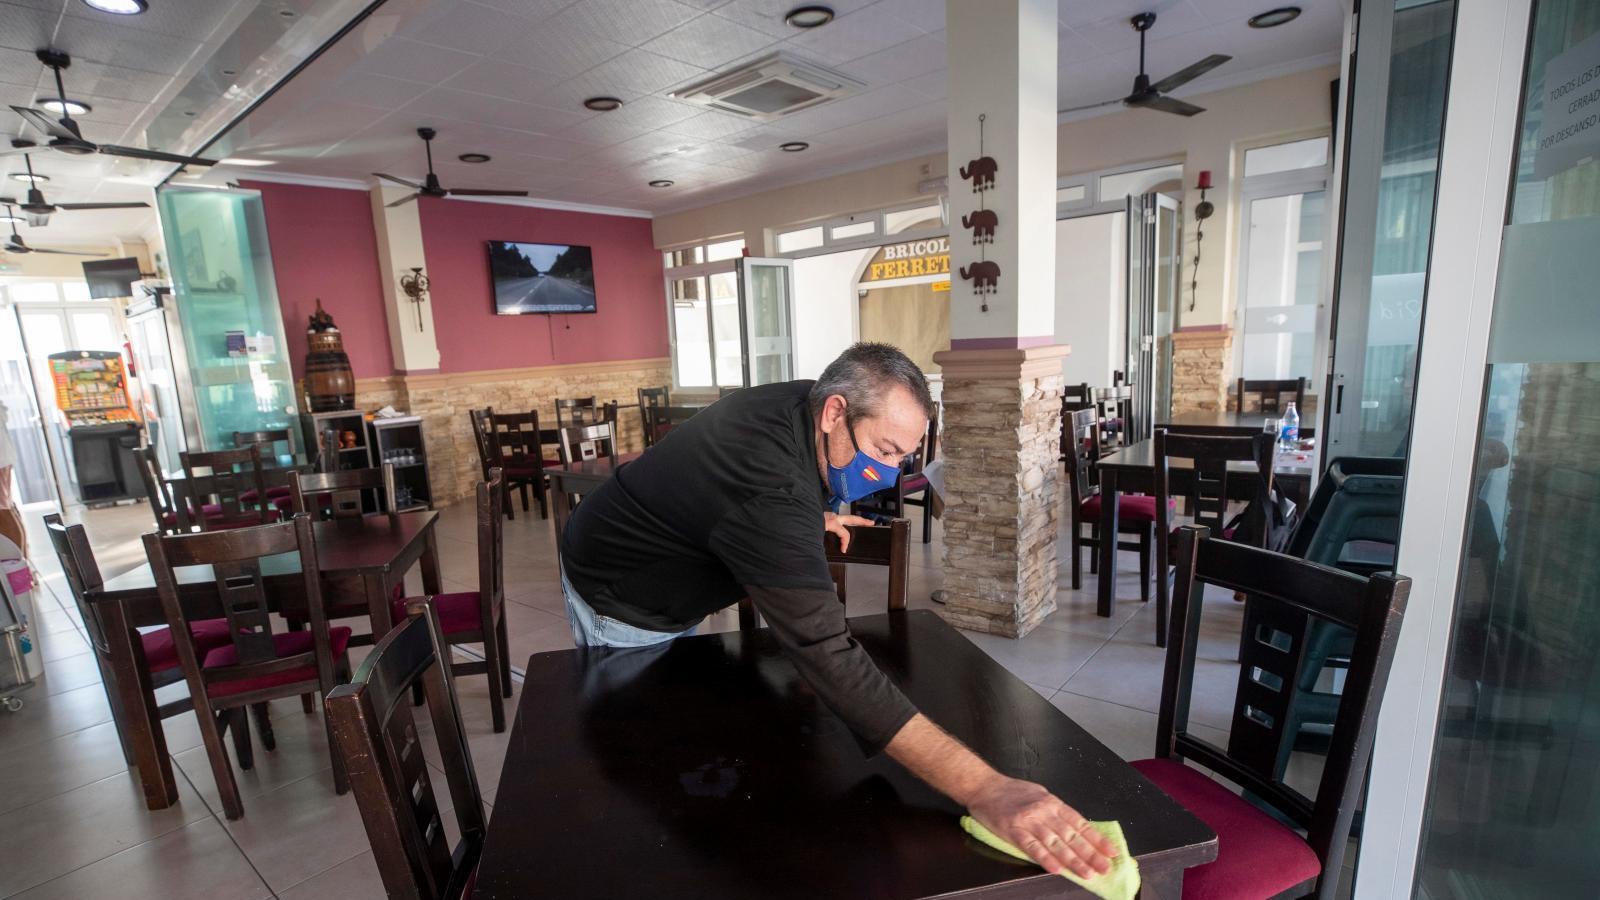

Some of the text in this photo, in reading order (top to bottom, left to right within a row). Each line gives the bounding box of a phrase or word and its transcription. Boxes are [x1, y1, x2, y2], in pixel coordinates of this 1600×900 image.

[1550, 79, 1575, 101] TODOS
[1577, 68, 1593, 87] LOS
[1541, 134, 1555, 150] POR
[1555, 114, 1597, 143] DESCANSO
[884, 238, 950, 260] BRICOL
[870, 255, 950, 280] FERRET
